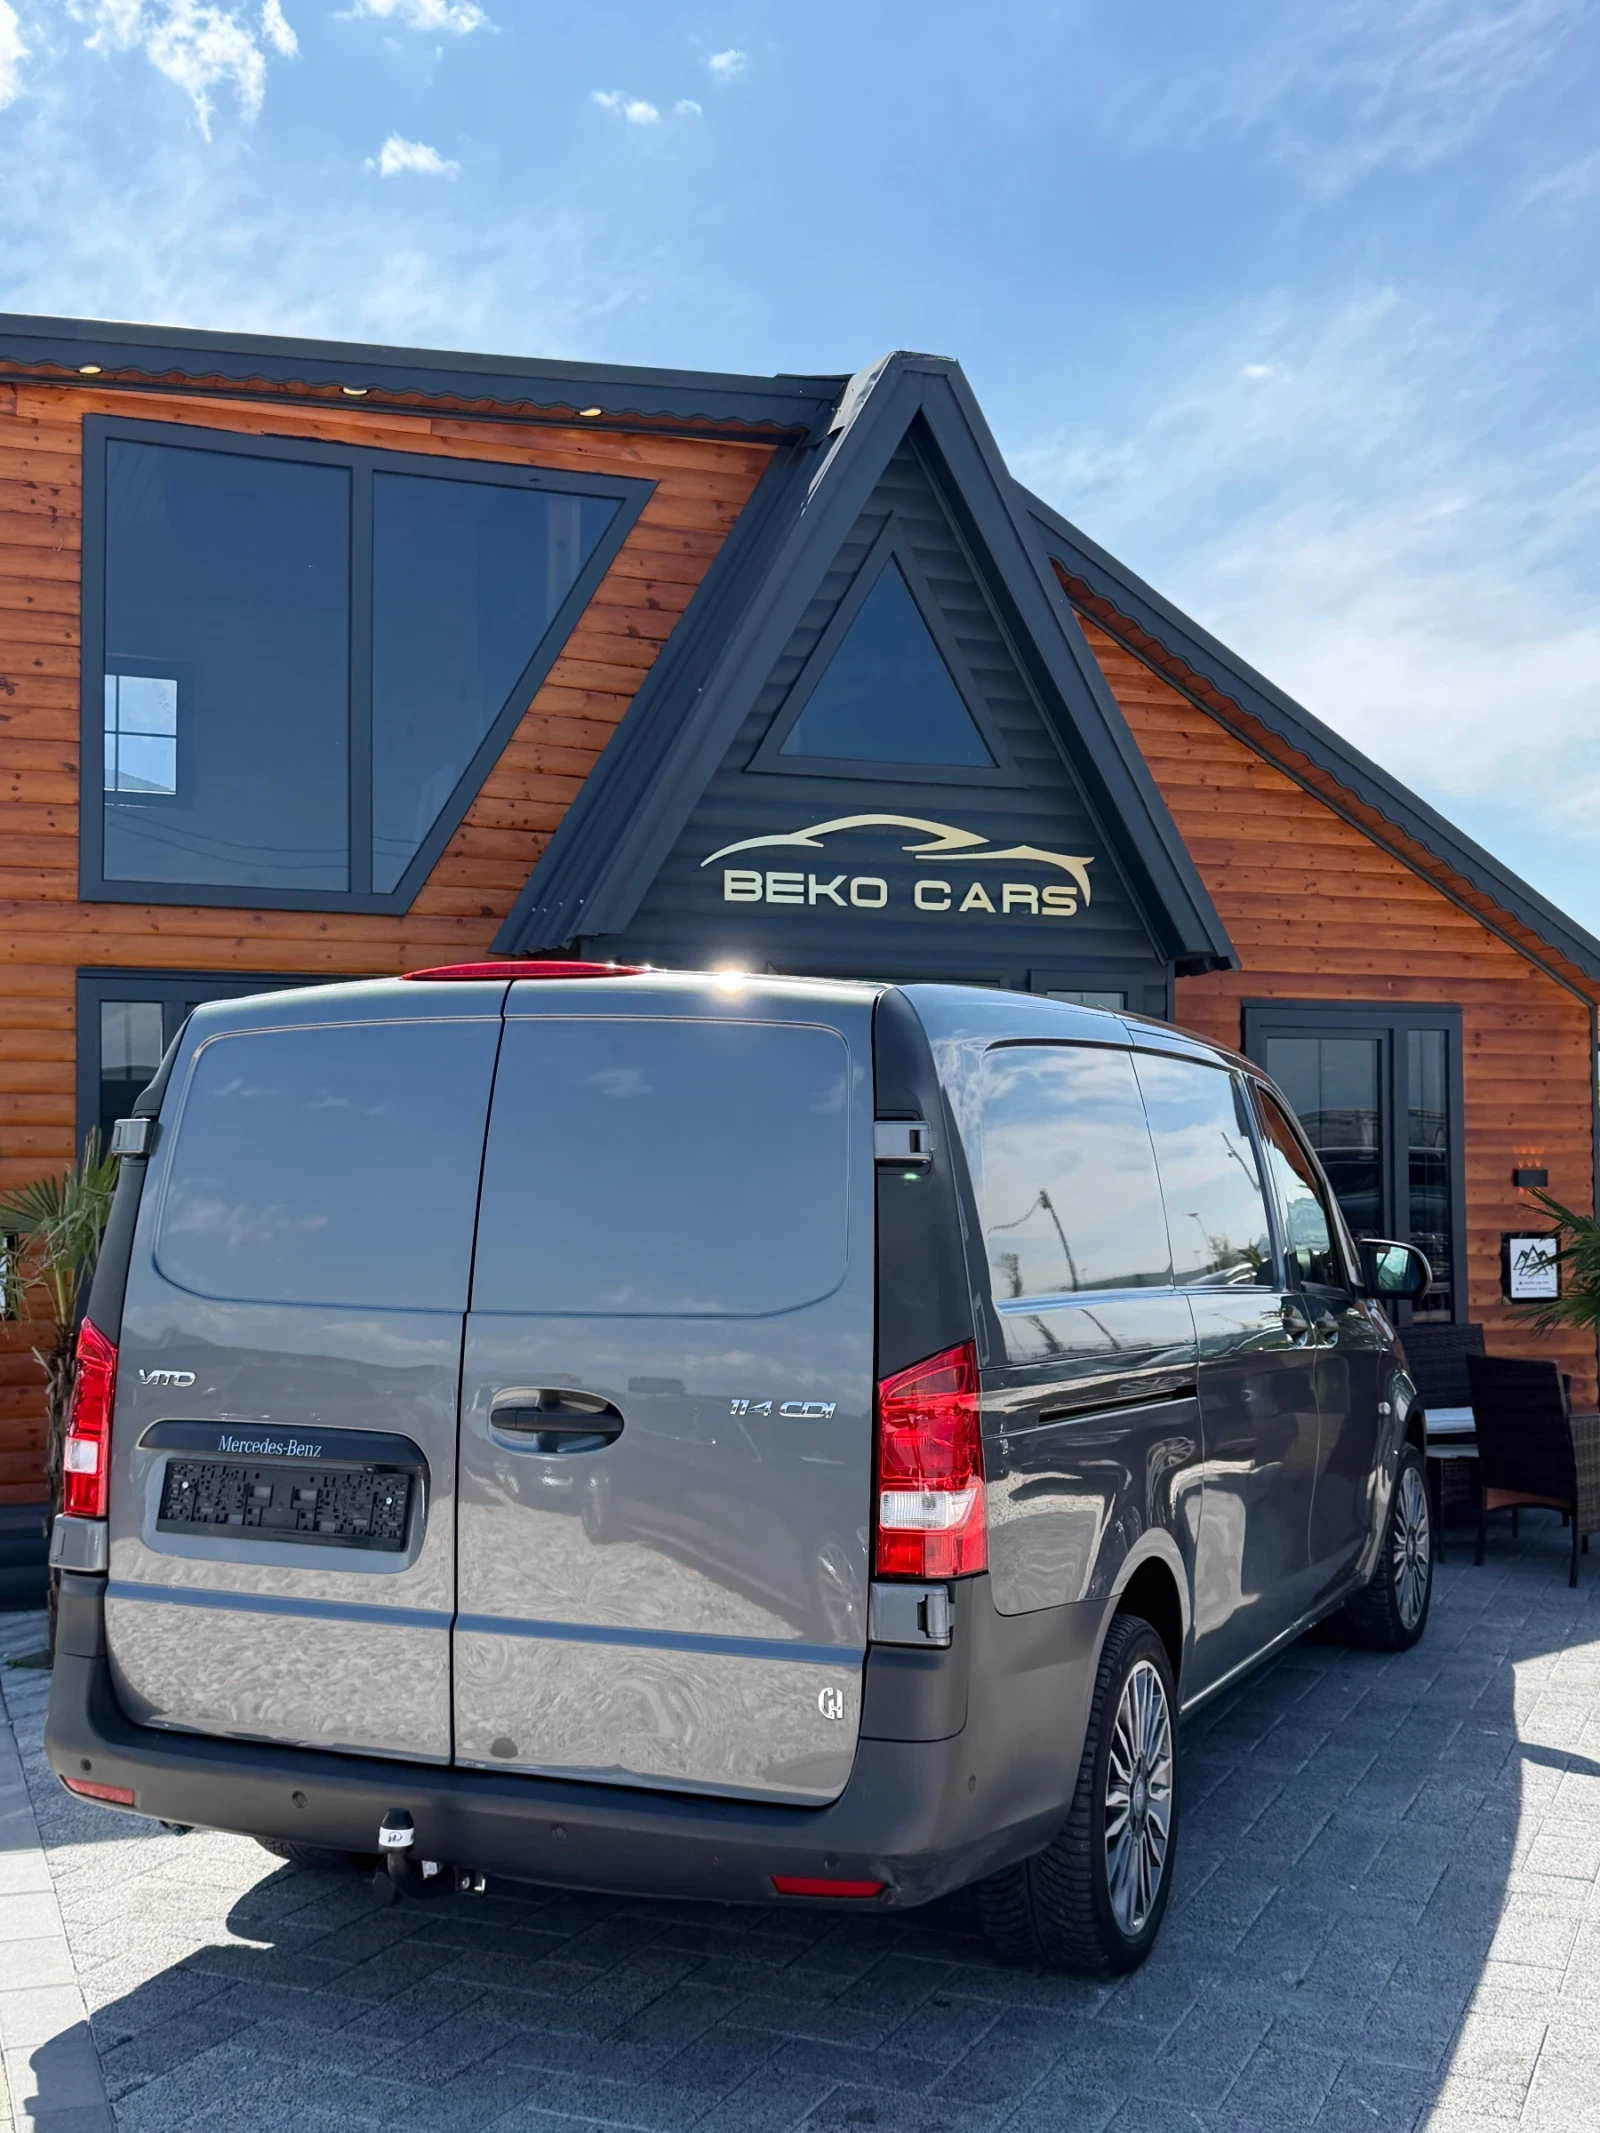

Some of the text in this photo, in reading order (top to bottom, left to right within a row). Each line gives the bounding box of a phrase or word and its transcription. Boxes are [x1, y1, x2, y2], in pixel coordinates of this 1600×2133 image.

[723, 869, 1078, 916] BEKO CARS
[139, 1369, 196, 1387] VITO
[730, 1399, 836, 1418] 114 CDI
[218, 1435, 322, 1457] Mercedes-Benz
